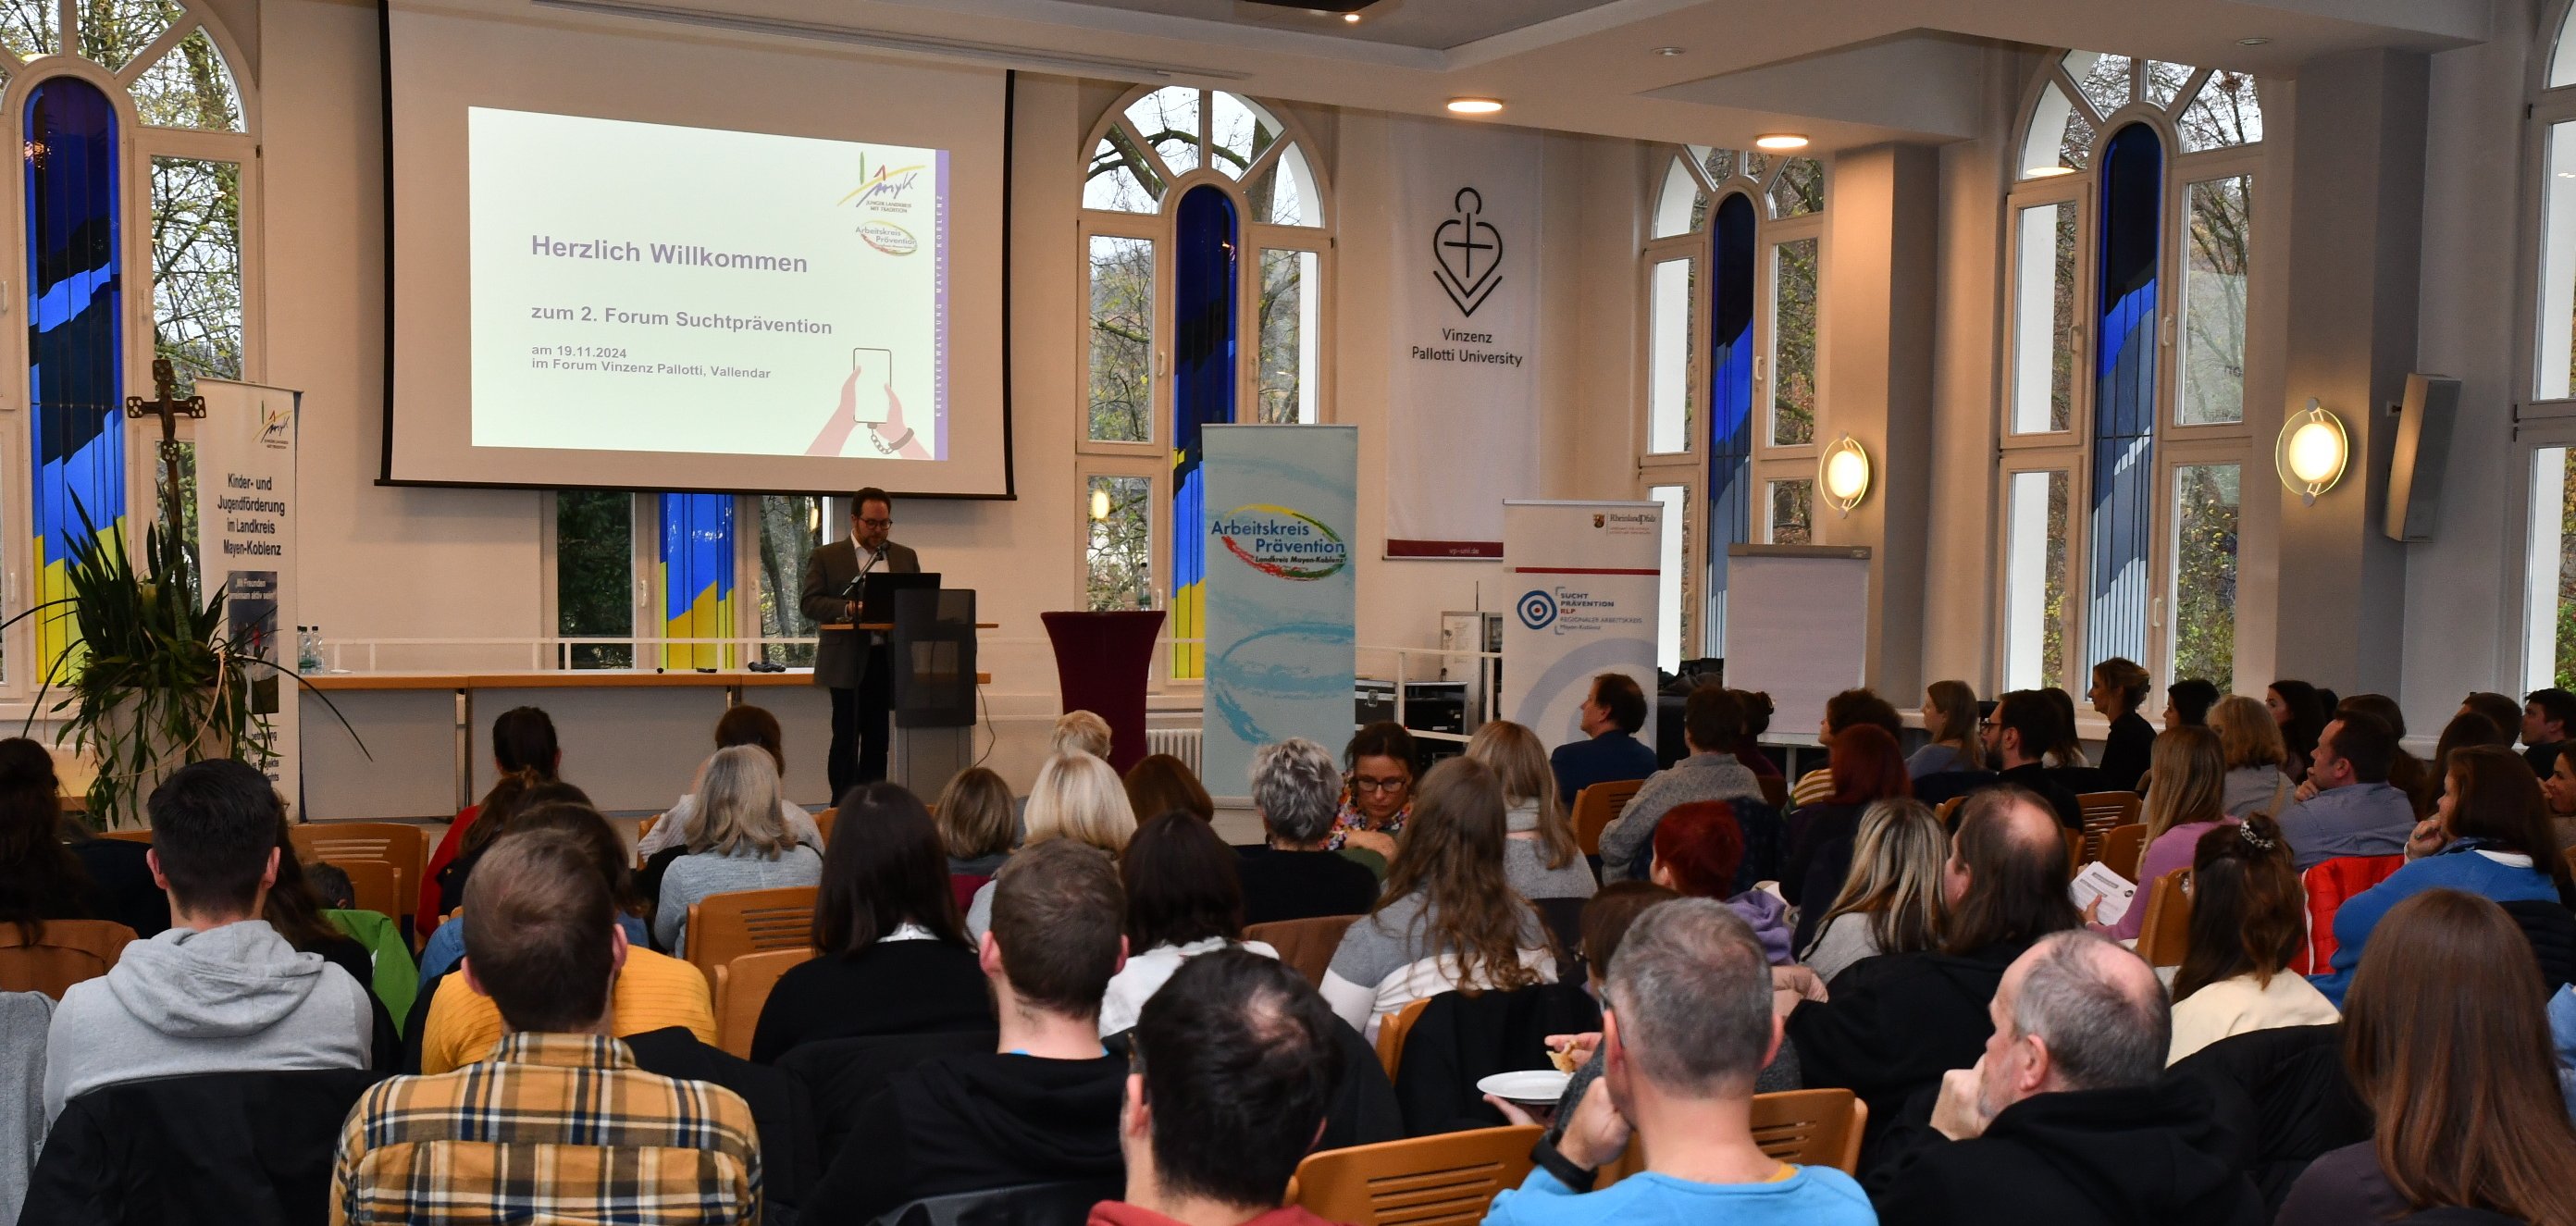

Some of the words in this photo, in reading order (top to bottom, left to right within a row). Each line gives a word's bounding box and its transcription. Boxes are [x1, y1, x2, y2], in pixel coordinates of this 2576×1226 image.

[855, 226, 901, 237] Arbeitskreis
[532, 234, 640, 262] Herzlich
[650, 242, 807, 273] Willkommen
[531, 307, 574, 321] zum
[581, 306, 598, 322] 2.
[605, 307, 668, 325] Forum
[676, 311, 832, 334] Suchtprävention
[1443, 328, 1492, 343] Vinzenz
[531, 346, 552, 355] am
[557, 345, 626, 358] 19.11.2024
[1412, 346, 1455, 361] Pallotti
[1459, 350, 1522, 367] University
[532, 358, 548, 369] im
[553, 358, 597, 371] Forum
[601, 361, 653, 373] Vinzenz
[657, 363, 707, 377] Pallotti,
[711, 365, 771, 378] Vallendar
[228, 473, 254, 489] Kinder-
[256, 477, 272, 490] und
[217, 494, 285, 516] Jugendförderung
[228, 517, 235, 532] im
[236, 518, 276, 534] Landkreis
[1211, 519, 1309, 535] Arbeitskreis
[224, 539, 281, 558] Mayen-Koblenz
[1256, 538, 1344, 552] Prävention
[1291, 556, 1344, 564] Mayen-Koblenz
